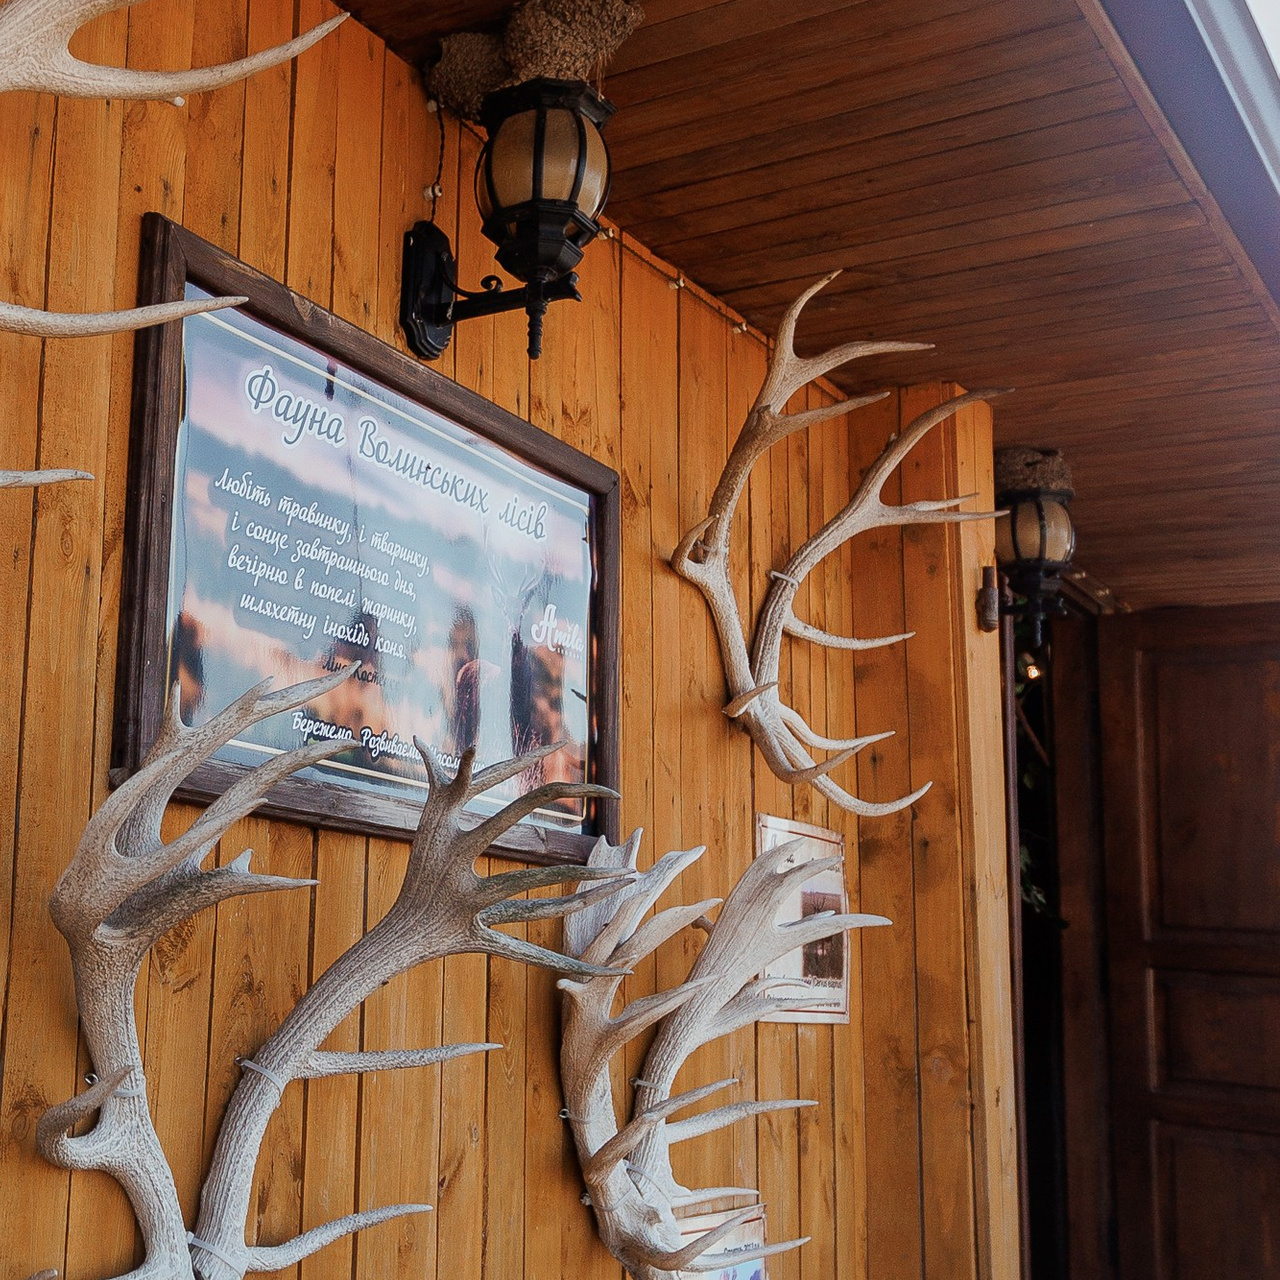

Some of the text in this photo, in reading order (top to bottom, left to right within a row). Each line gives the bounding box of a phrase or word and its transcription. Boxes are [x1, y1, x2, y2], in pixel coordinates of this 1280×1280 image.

[247, 368, 547, 540] Фауна Волинських лісів
[214, 468, 430, 578] Любіть травинку, і тваринку,
[231, 511, 417, 602] і сонце завтрашнього дня,
[227, 544, 418, 638] вечірню в попелі жаринку,
[239, 593, 407, 660] шляхетну інохідь коня.
[530, 603, 585, 653] Amila
